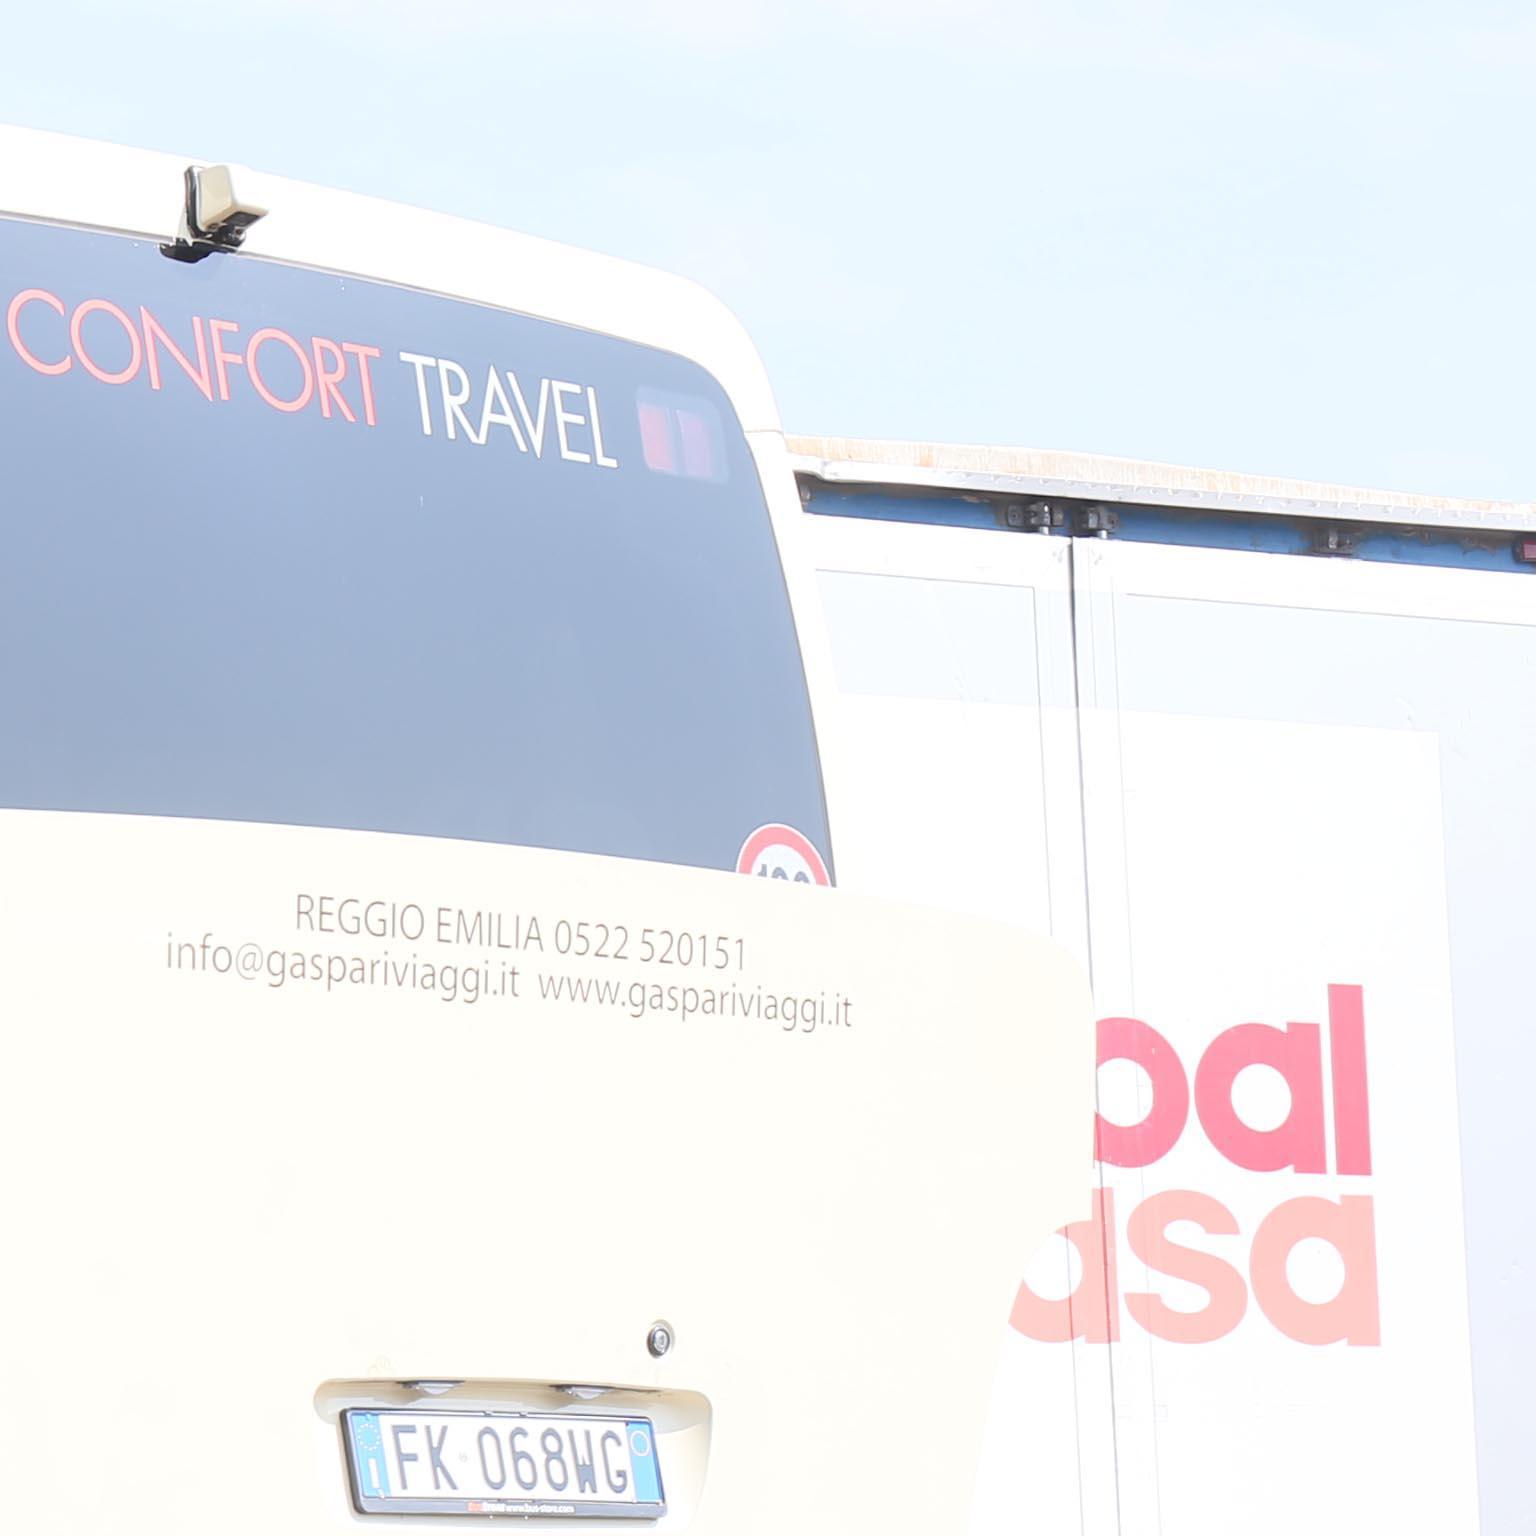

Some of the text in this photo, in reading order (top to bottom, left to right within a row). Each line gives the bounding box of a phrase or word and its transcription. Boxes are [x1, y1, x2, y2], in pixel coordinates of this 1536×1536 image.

[7, 289, 381, 428] CONFORT
[399, 351, 619, 469] TRAVEL
[296, 893, 747, 972] REGGIO EMILIA 0522 520151
[165, 931, 854, 1034] info@gaspariviaggi.it www.gaspariviaggi.it
[390, 1424, 630, 1495] FK 068WG
